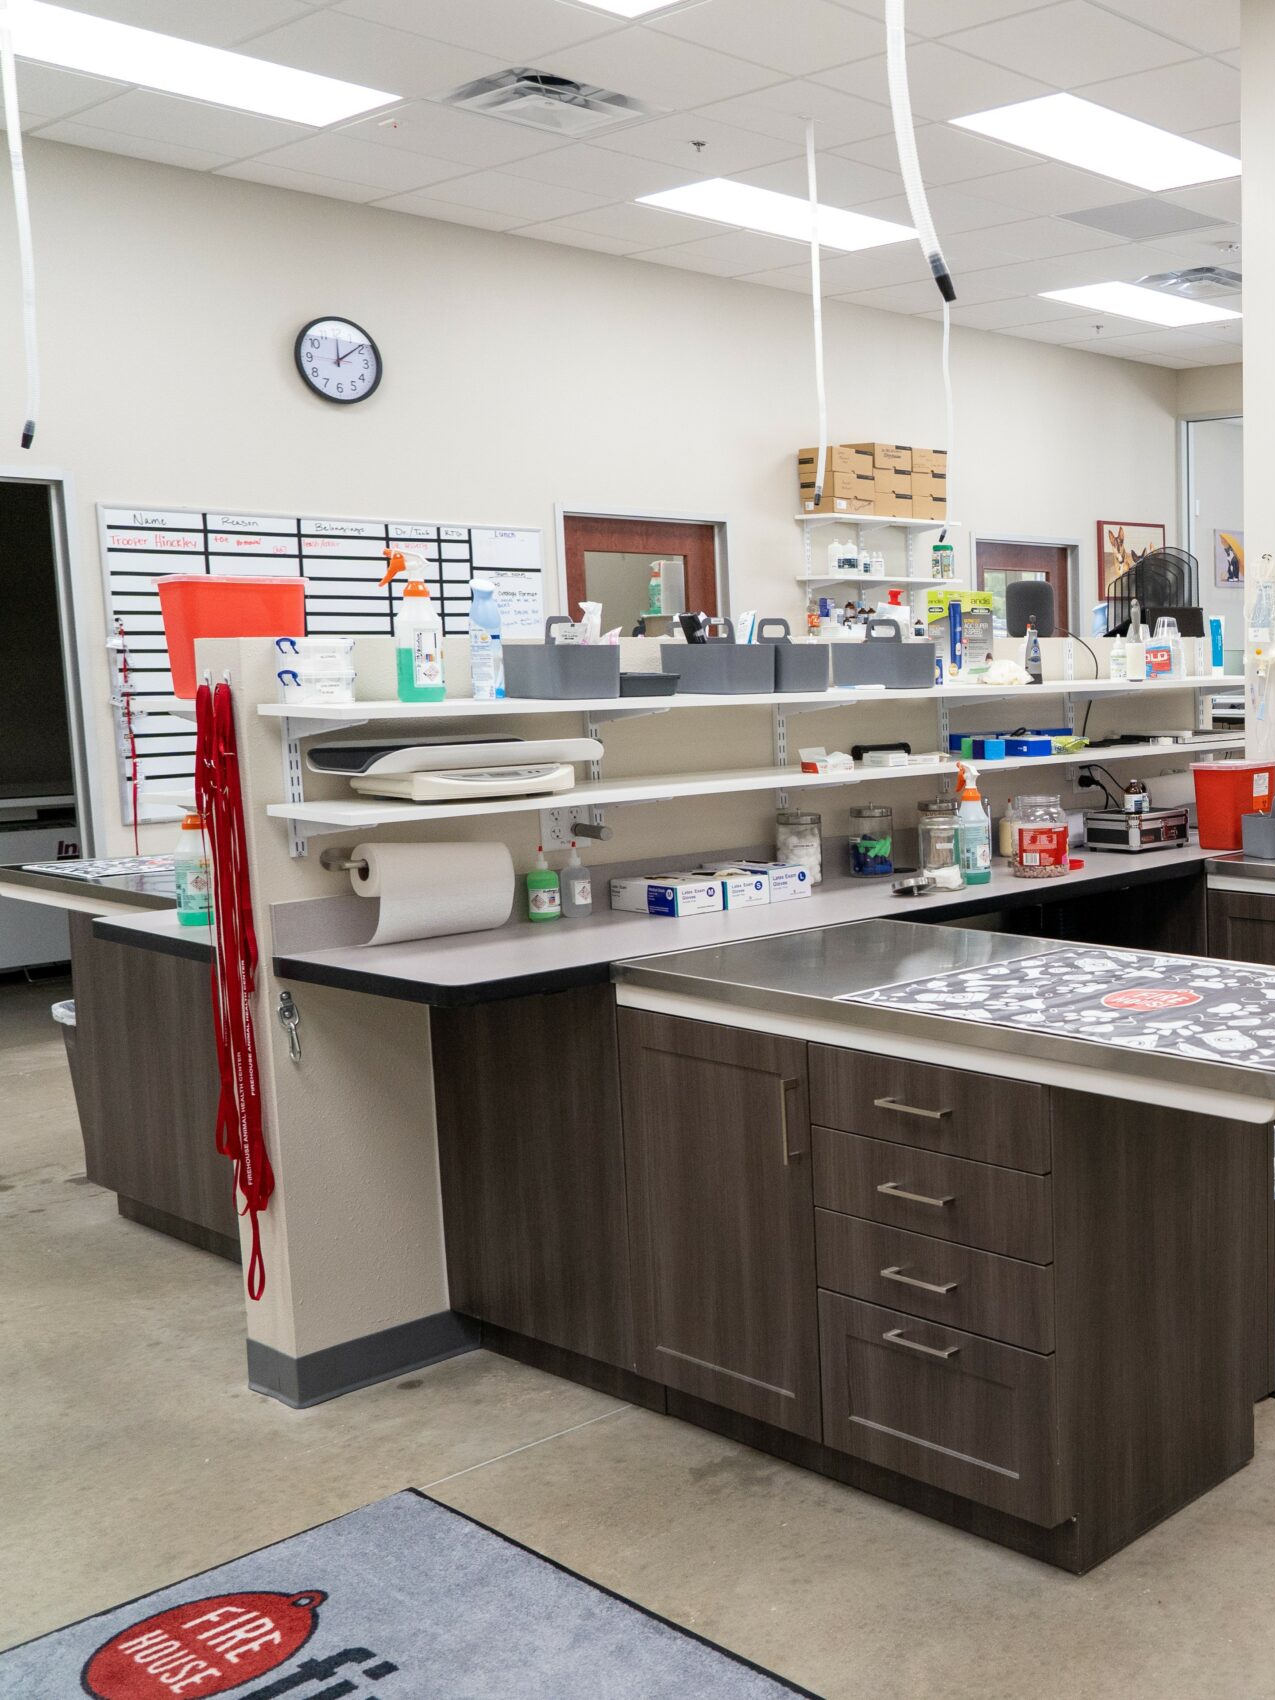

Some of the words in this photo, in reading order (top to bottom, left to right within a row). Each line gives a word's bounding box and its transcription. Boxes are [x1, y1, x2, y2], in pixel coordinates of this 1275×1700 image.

[309, 338, 321, 350] 10
[358, 343, 365, 355] 2
[305, 351, 313, 363] 9
[363, 359, 370, 370] 3
[311, 367, 319, 378] 8
[358, 373, 365, 384] 4
[322, 377, 330, 388] 7
[336, 383, 344, 393] 6
[350, 380, 357, 392] 5
[133, 513, 167, 526] Name
[221, 516, 259, 527] Reason
[494, 530, 516, 538] Lunch
[110, 535, 149, 547] Trooper
[247, 1053, 256, 1096] FIREHOUSE
[241, 1113, 249, 1142] ANIMAL
[243, 1143, 253, 1186] FIREHOUSE
[182, 1605, 283, 1664] FIRE
[118, 1629, 222, 1695] HOUSE
